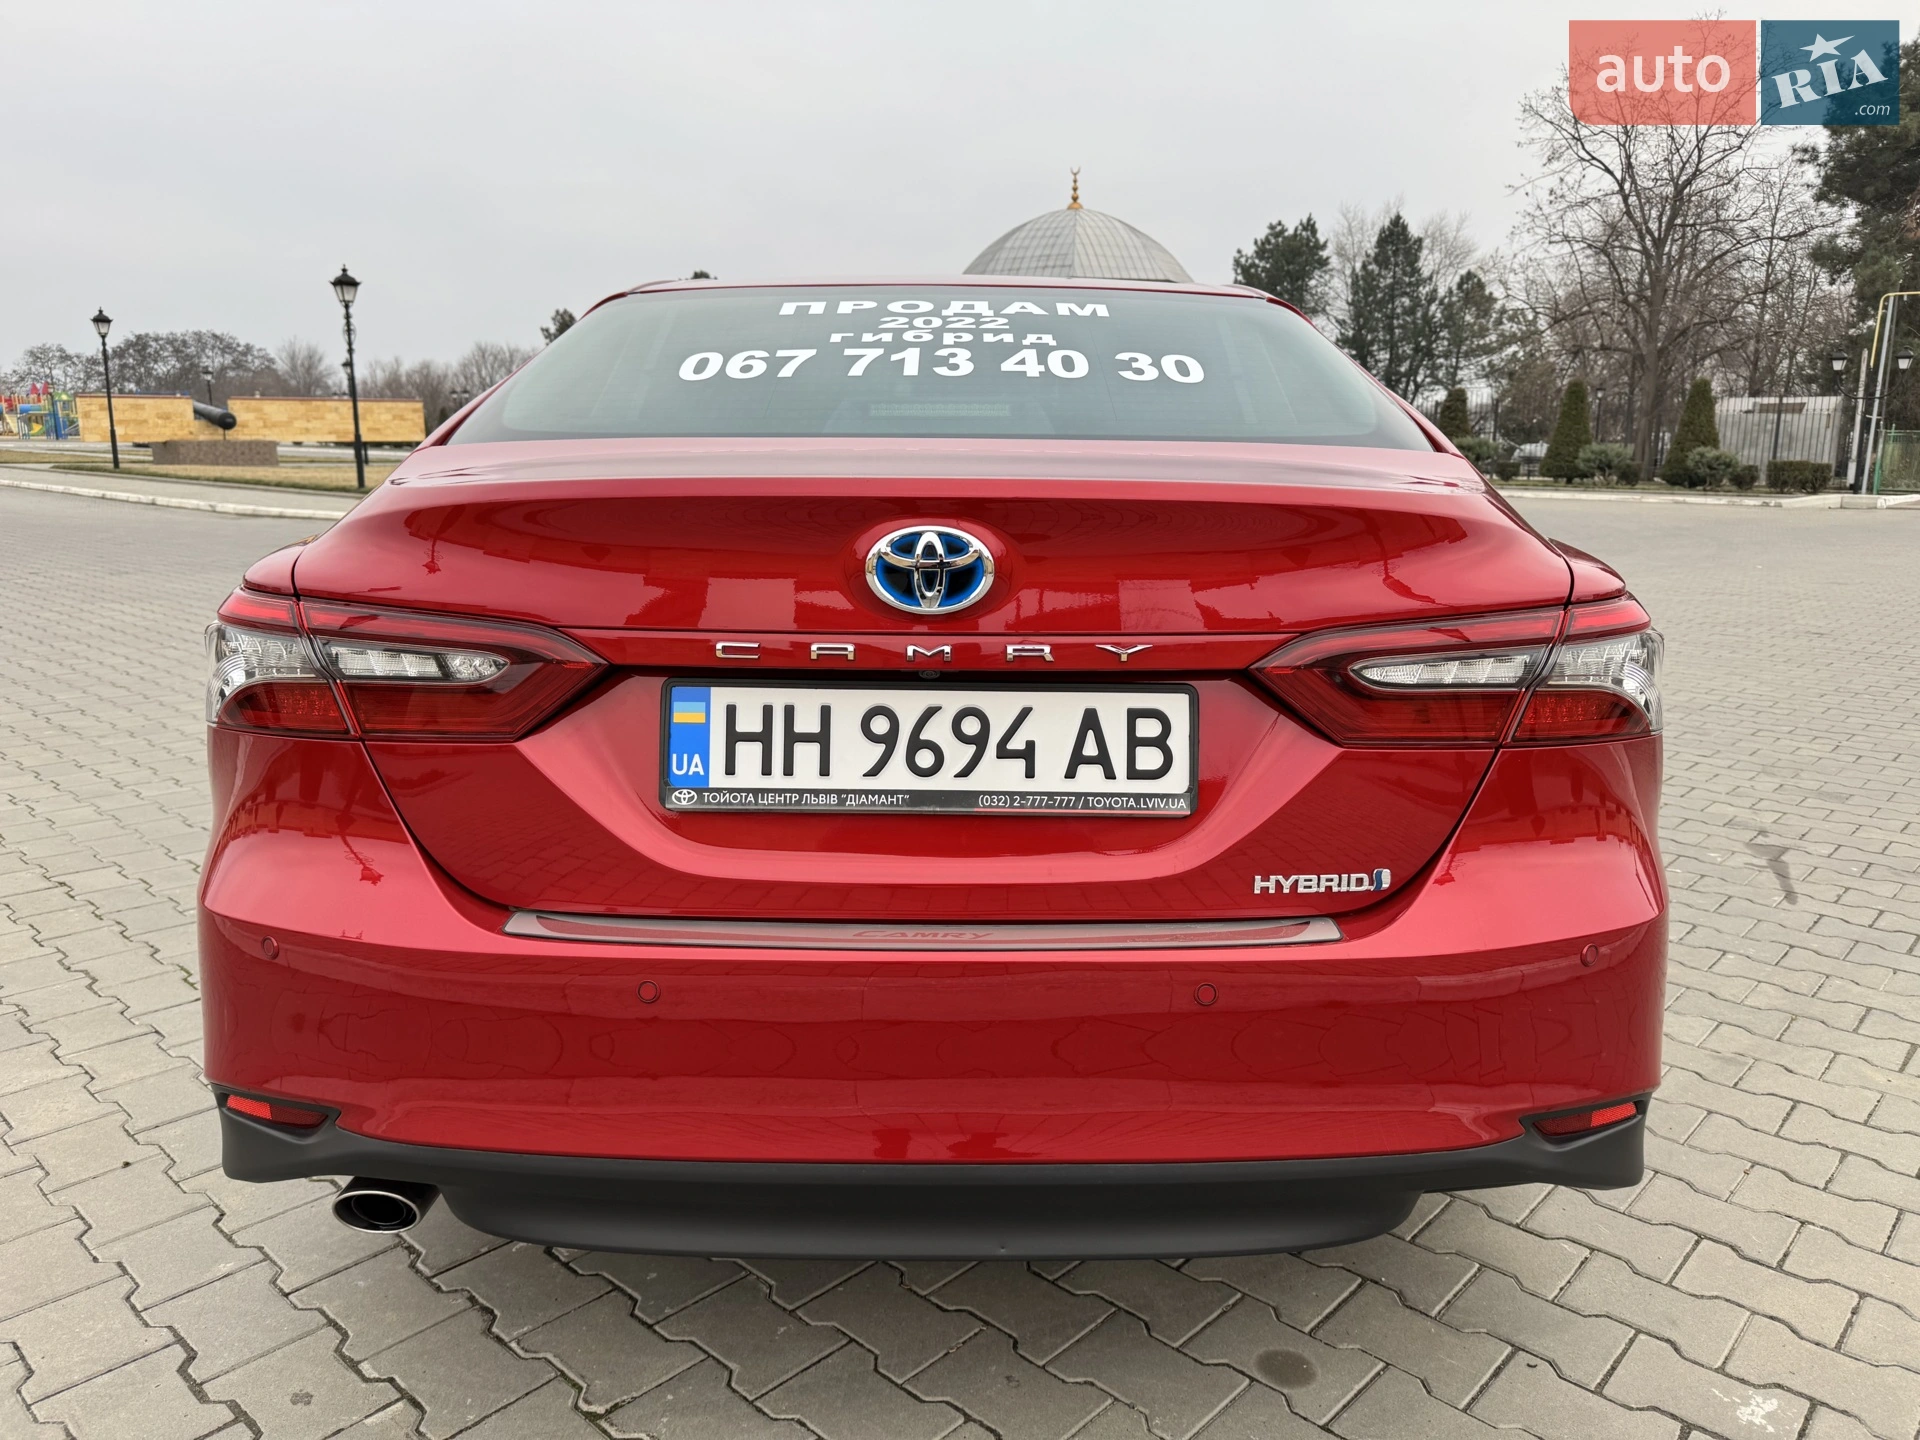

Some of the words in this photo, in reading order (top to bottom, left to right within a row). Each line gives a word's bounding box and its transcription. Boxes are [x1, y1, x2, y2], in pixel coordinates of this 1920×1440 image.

[778, 300, 1110, 317] ПРОДАМ
[878, 316, 1010, 329] 2022
[829, 329, 1057, 346] гибрид
[678, 349, 817, 381] 067
[843, 347, 975, 377] 713
[1000, 349, 1089, 379] 40
[1114, 352, 1205, 384] 30
[715, 641, 1154, 662] CAMRY
[724, 704, 832, 776] HH
[860, 705, 1036, 778] 9694
[1063, 707, 1174, 780] AB
[672, 754, 704, 776] UA
[703, 790, 755, 804] ТОЙОТА
[758, 793, 799, 806] ЦЕНТР
[978, 795, 1010, 807] (032)
[1013, 796, 1076, 807] 2-777-777
[1078, 796, 1084, 809] /
[1087, 797, 1187, 809] TOYOTA.LVIV.UA
[1254, 873, 1370, 894] HYBRID
[852, 930, 994, 940] CAMRY
